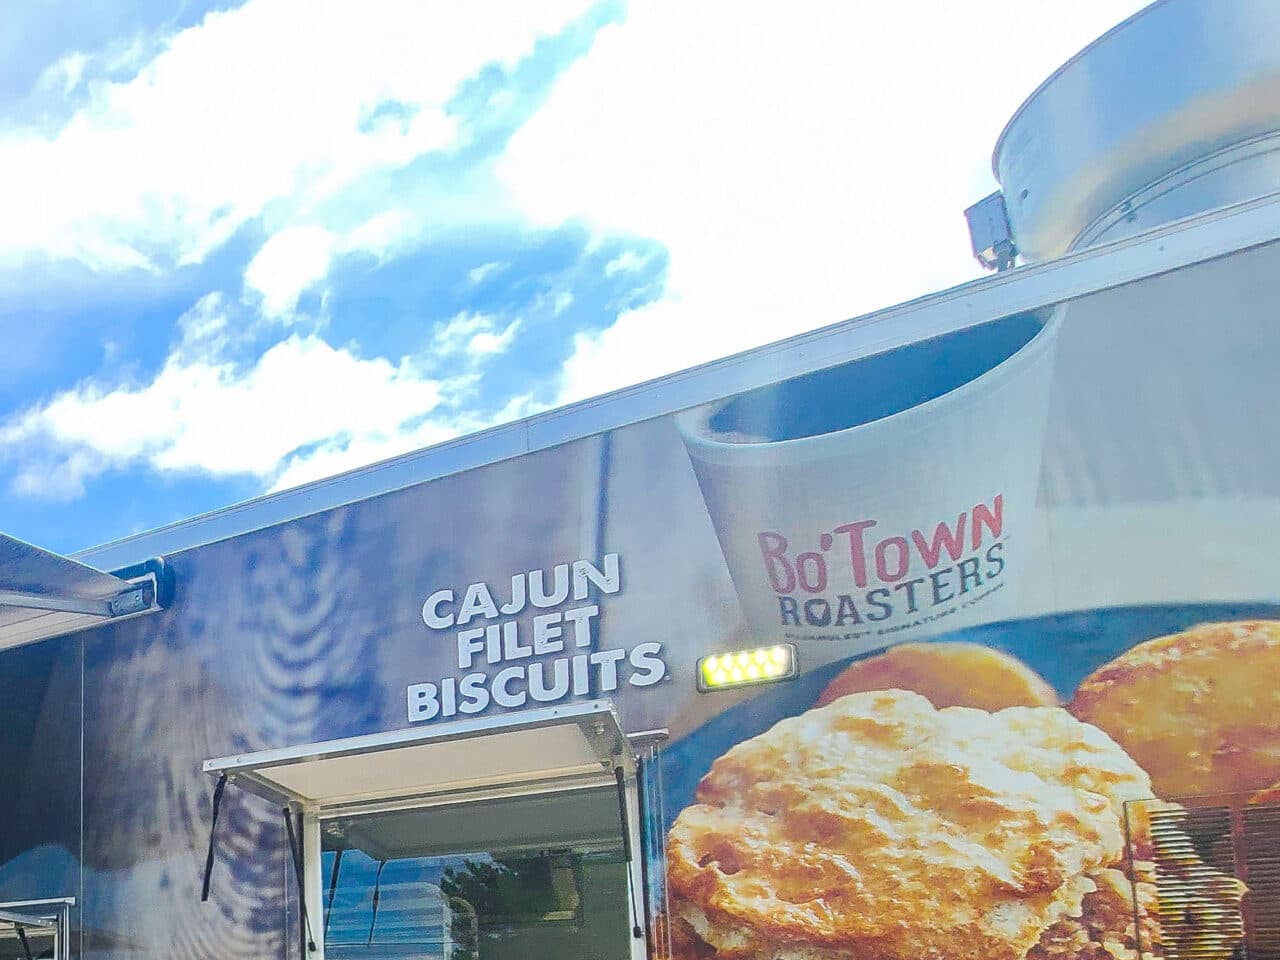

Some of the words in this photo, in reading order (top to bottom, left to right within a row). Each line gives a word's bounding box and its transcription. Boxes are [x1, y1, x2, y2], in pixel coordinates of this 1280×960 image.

[422, 553, 620, 630] CAJUN
[776, 541, 1006, 628] ROASTERS
[457, 605, 599, 669] FILET
[407, 642, 667, 723] BISCUITS
